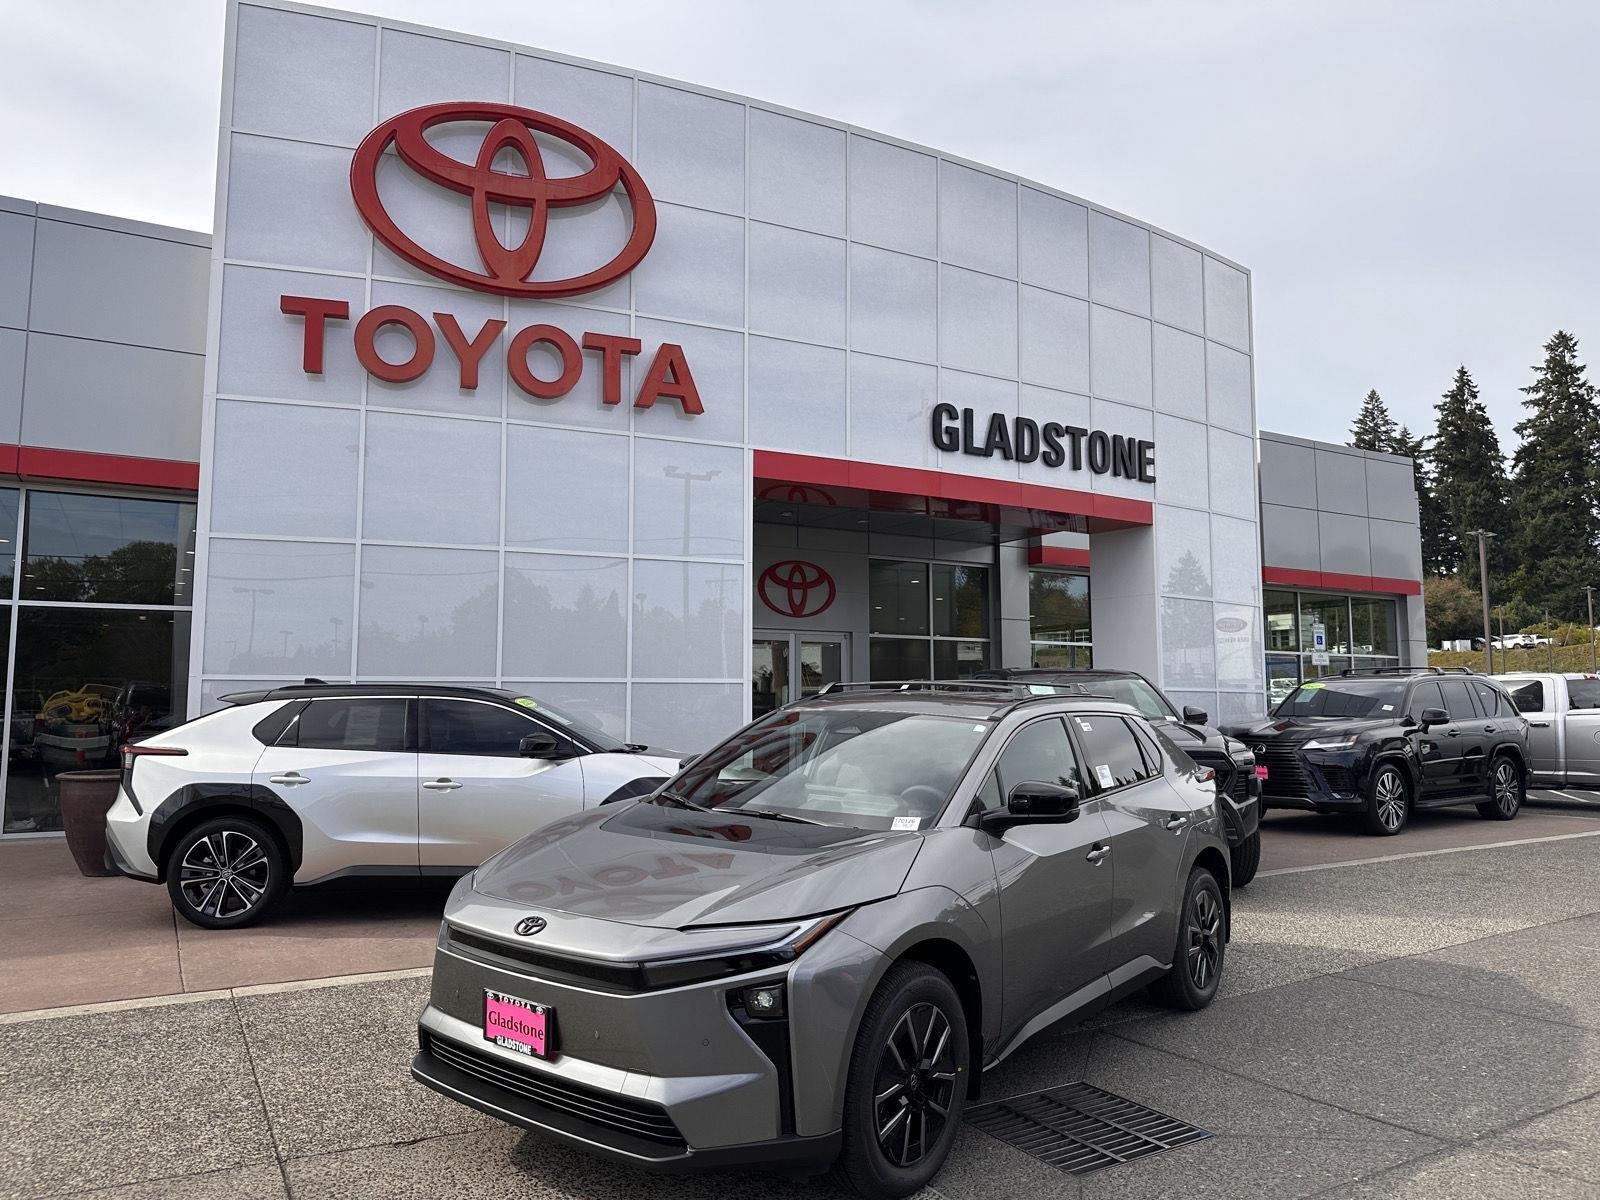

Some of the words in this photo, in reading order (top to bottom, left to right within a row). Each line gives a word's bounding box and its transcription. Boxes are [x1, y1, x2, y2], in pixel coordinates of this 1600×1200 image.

[280, 295, 704, 415] TOYOTA
[931, 402, 1156, 483] GLADSTONE
[498, 994, 531, 1010] TOYOTA
[488, 1010, 544, 1041] Gladstone
[496, 1035, 532, 1055] GLADSTONE
